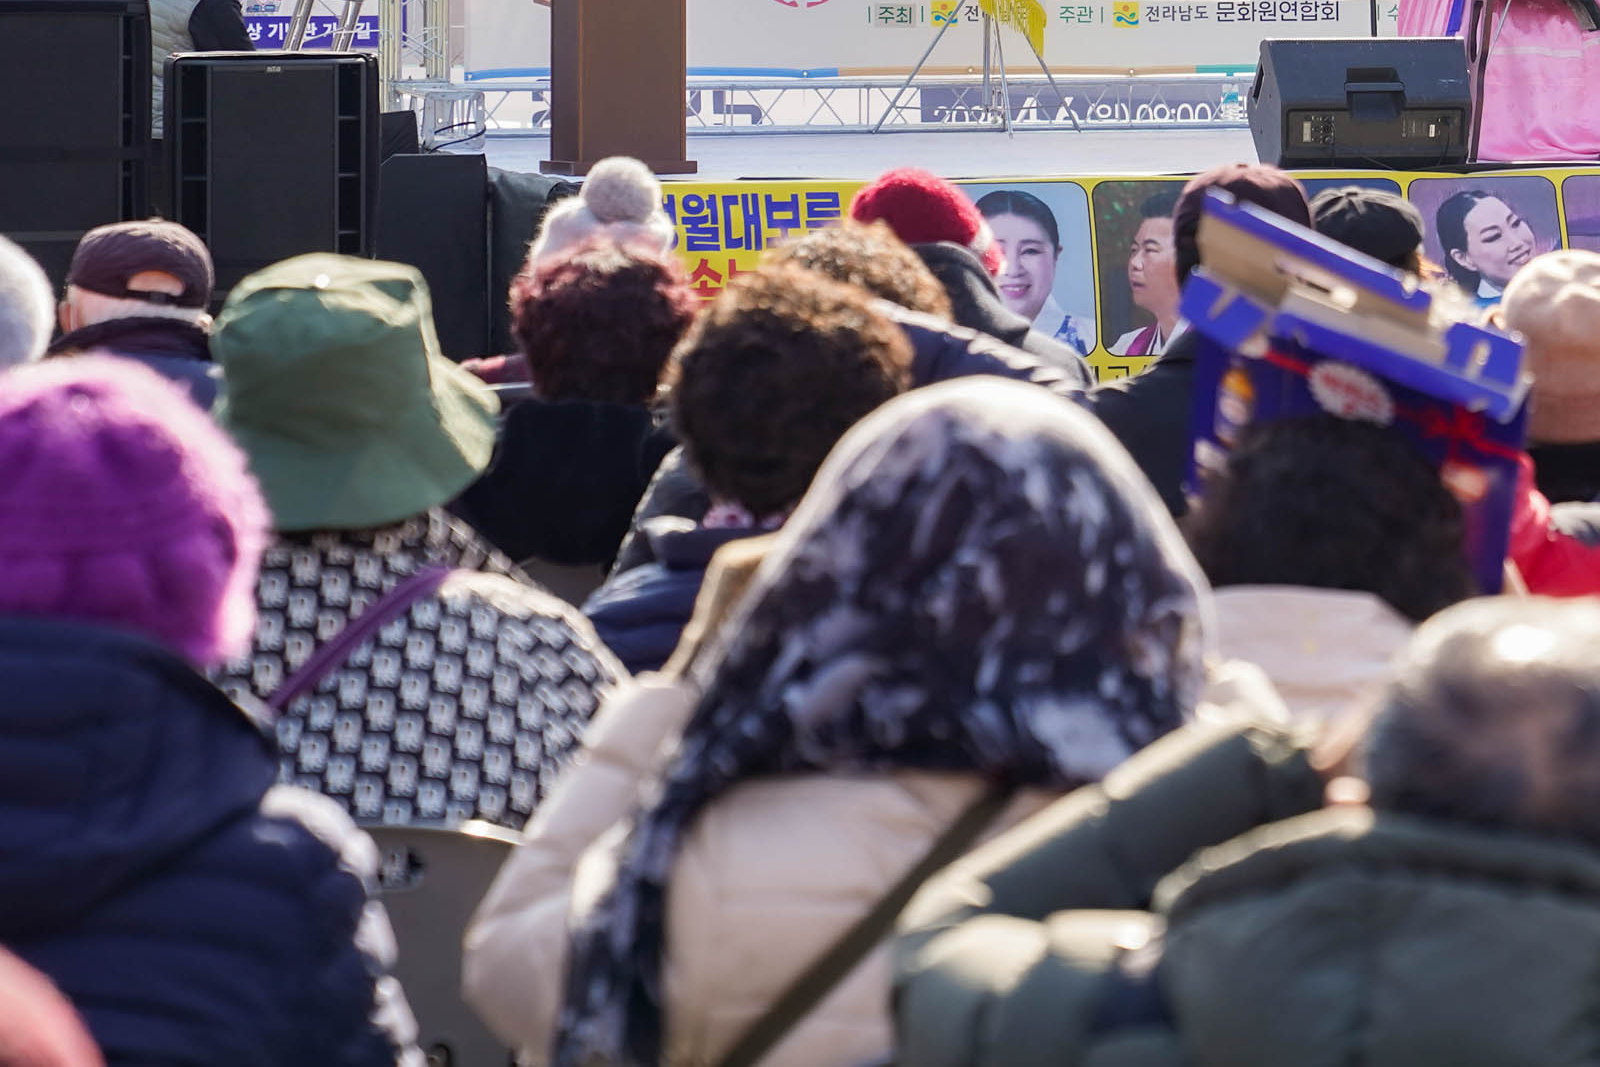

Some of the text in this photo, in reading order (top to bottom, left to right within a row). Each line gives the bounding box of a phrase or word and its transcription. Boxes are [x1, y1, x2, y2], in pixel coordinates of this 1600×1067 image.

[877, 5, 914, 25] 주최
[1058, 0, 1341, 24] 주관 전라남도 문화원연합회
